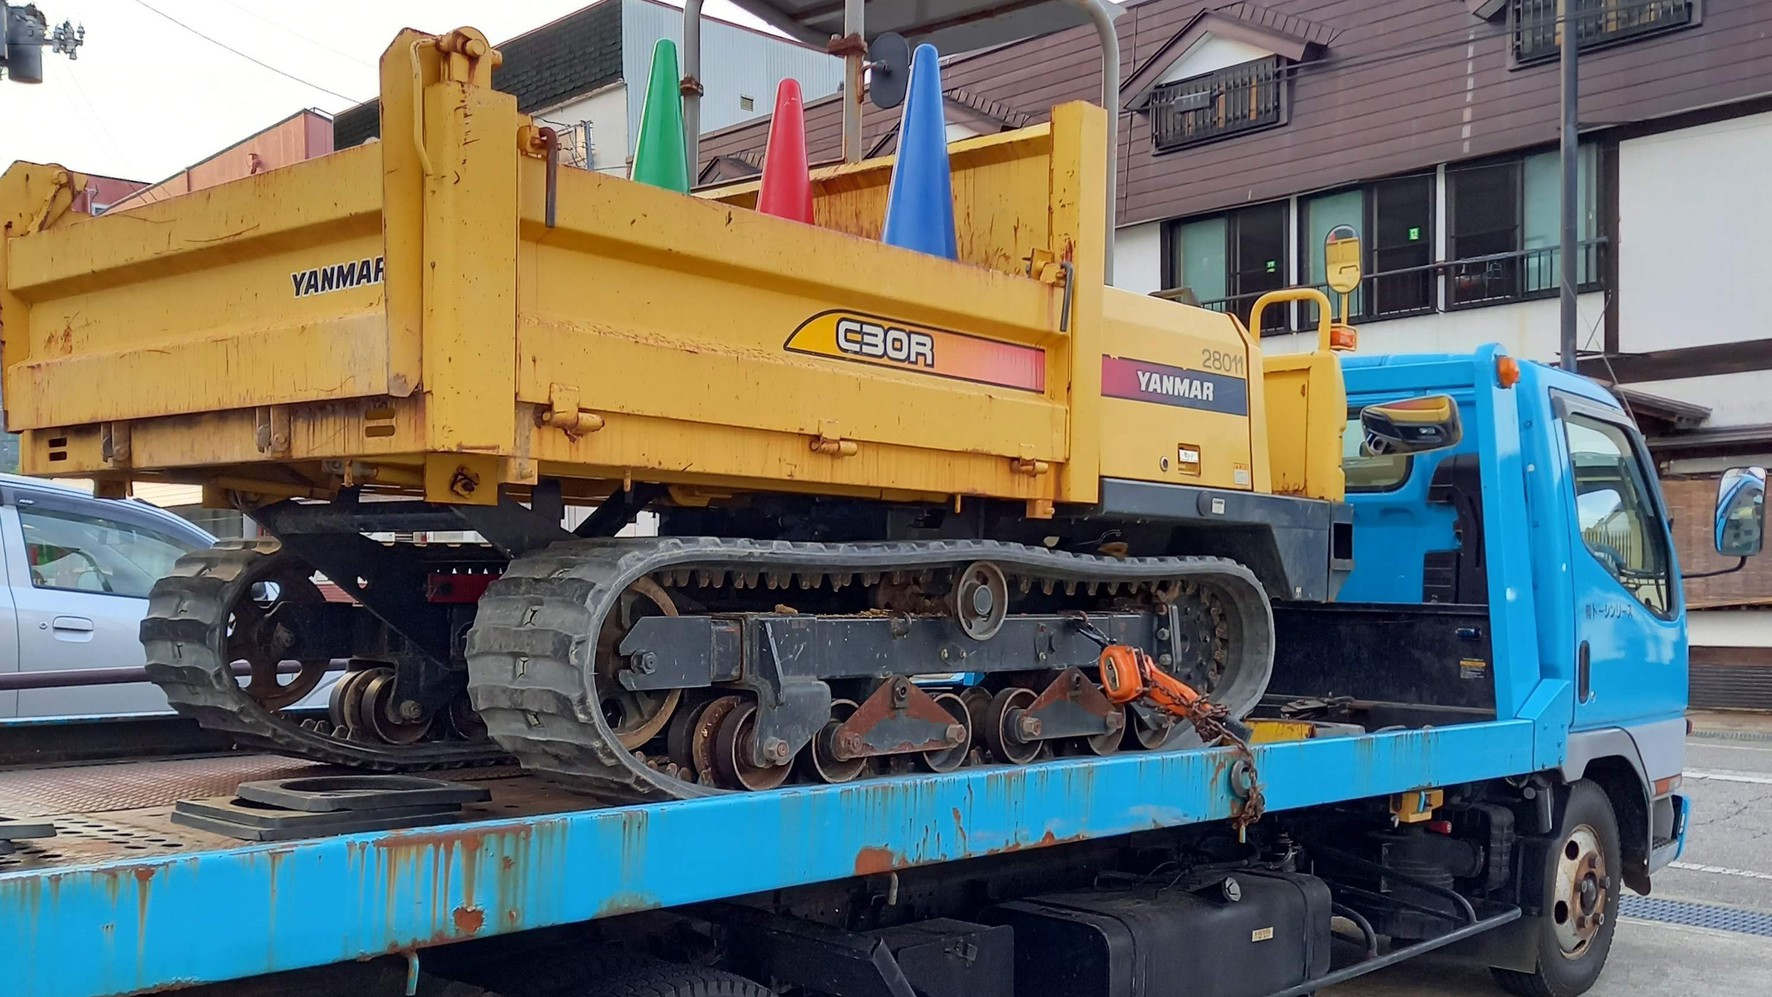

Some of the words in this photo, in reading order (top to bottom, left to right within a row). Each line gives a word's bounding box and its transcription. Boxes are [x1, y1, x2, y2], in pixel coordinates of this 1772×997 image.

[837, 317, 934, 368] C30R
[1202, 348, 1244, 375] 28011
[1137, 370, 1214, 401] YANMAR
